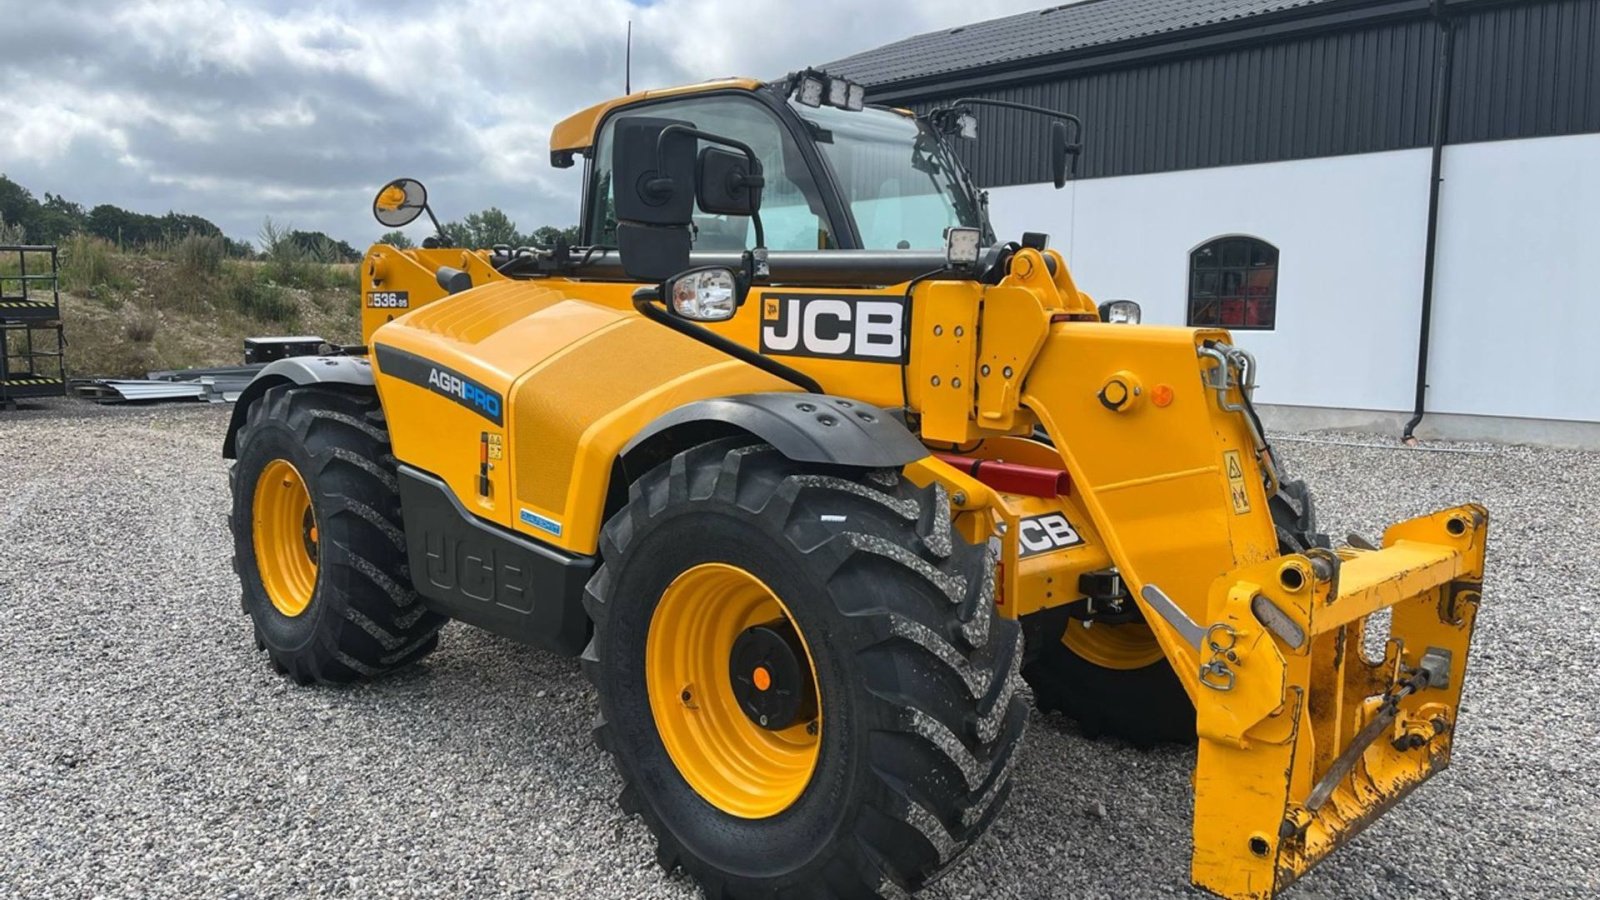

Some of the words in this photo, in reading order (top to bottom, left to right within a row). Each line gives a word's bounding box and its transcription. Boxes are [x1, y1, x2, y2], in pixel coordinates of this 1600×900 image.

[763, 299, 904, 358] JCB
[428, 367, 500, 417] AGRIPRO
[425, 530, 535, 614] JCB
